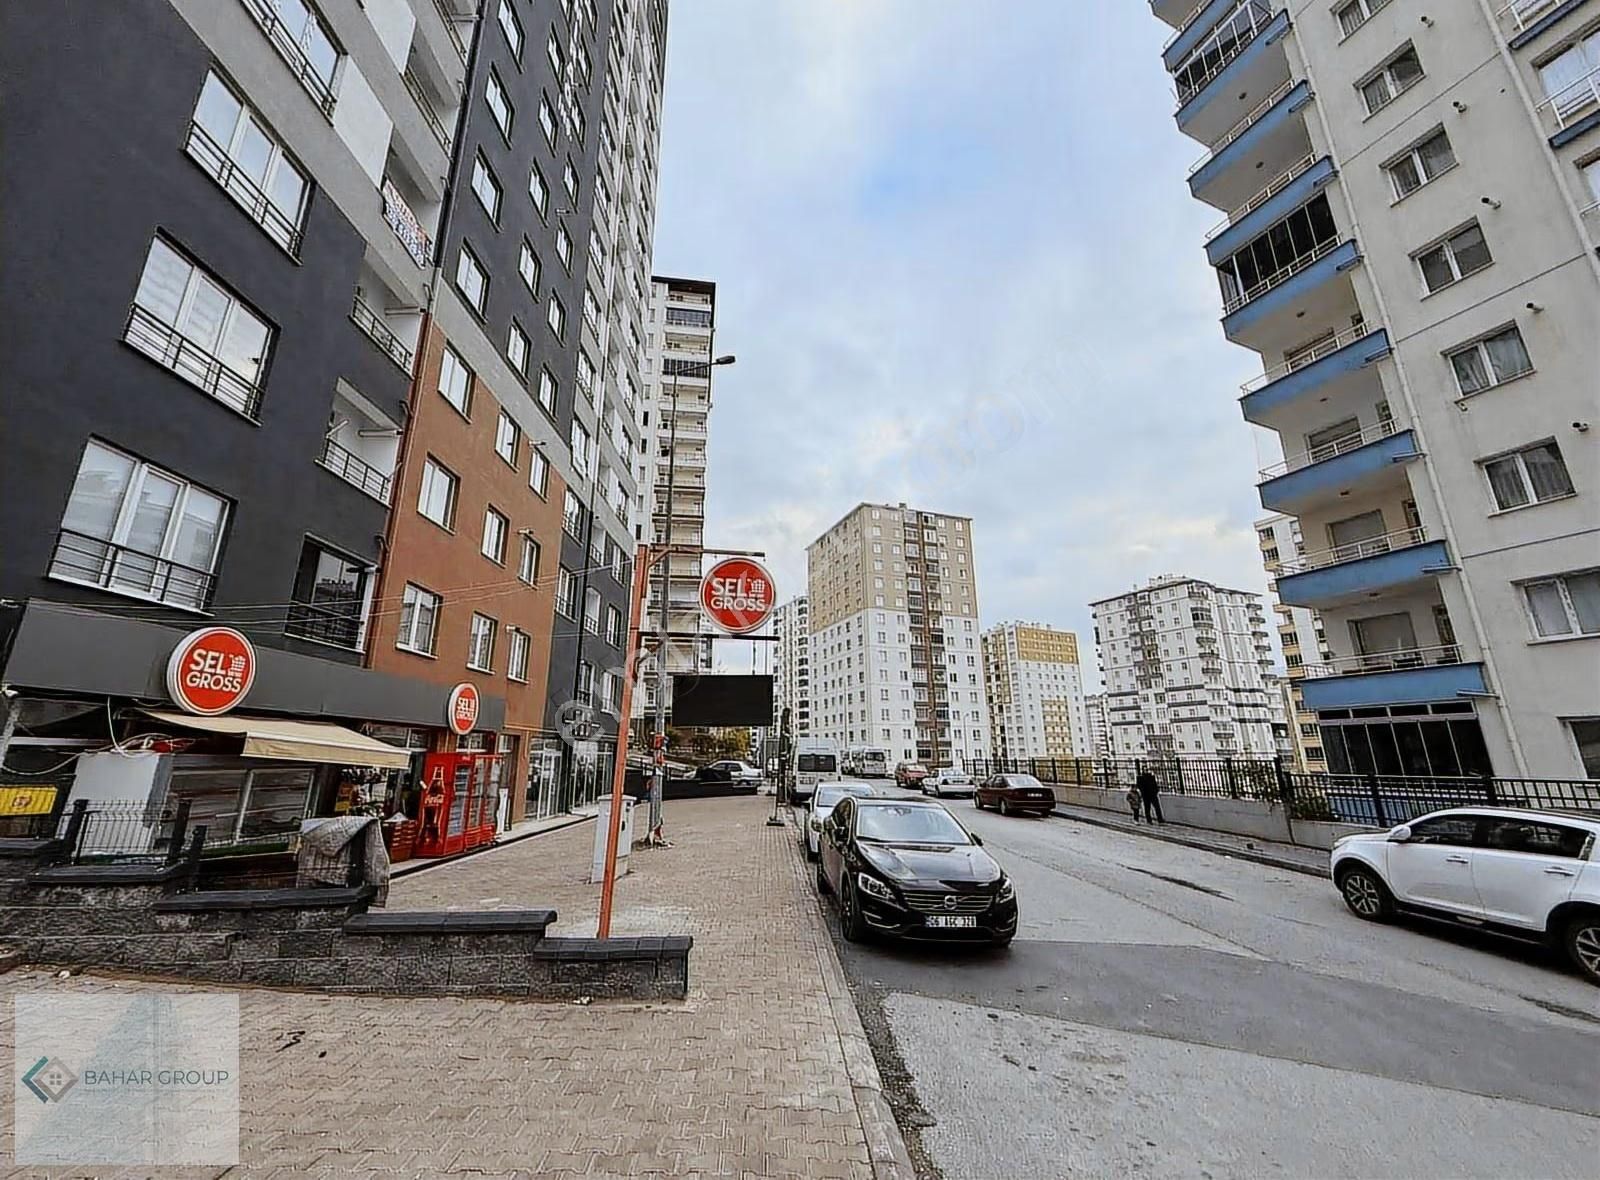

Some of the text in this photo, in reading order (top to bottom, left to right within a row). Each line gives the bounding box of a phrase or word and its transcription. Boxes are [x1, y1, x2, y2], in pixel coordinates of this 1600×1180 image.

[711, 577, 747, 597] SEL
[710, 596, 766, 612] GROSS
[189, 648, 226, 675] SEL
[186, 671, 242, 694] GROSS
